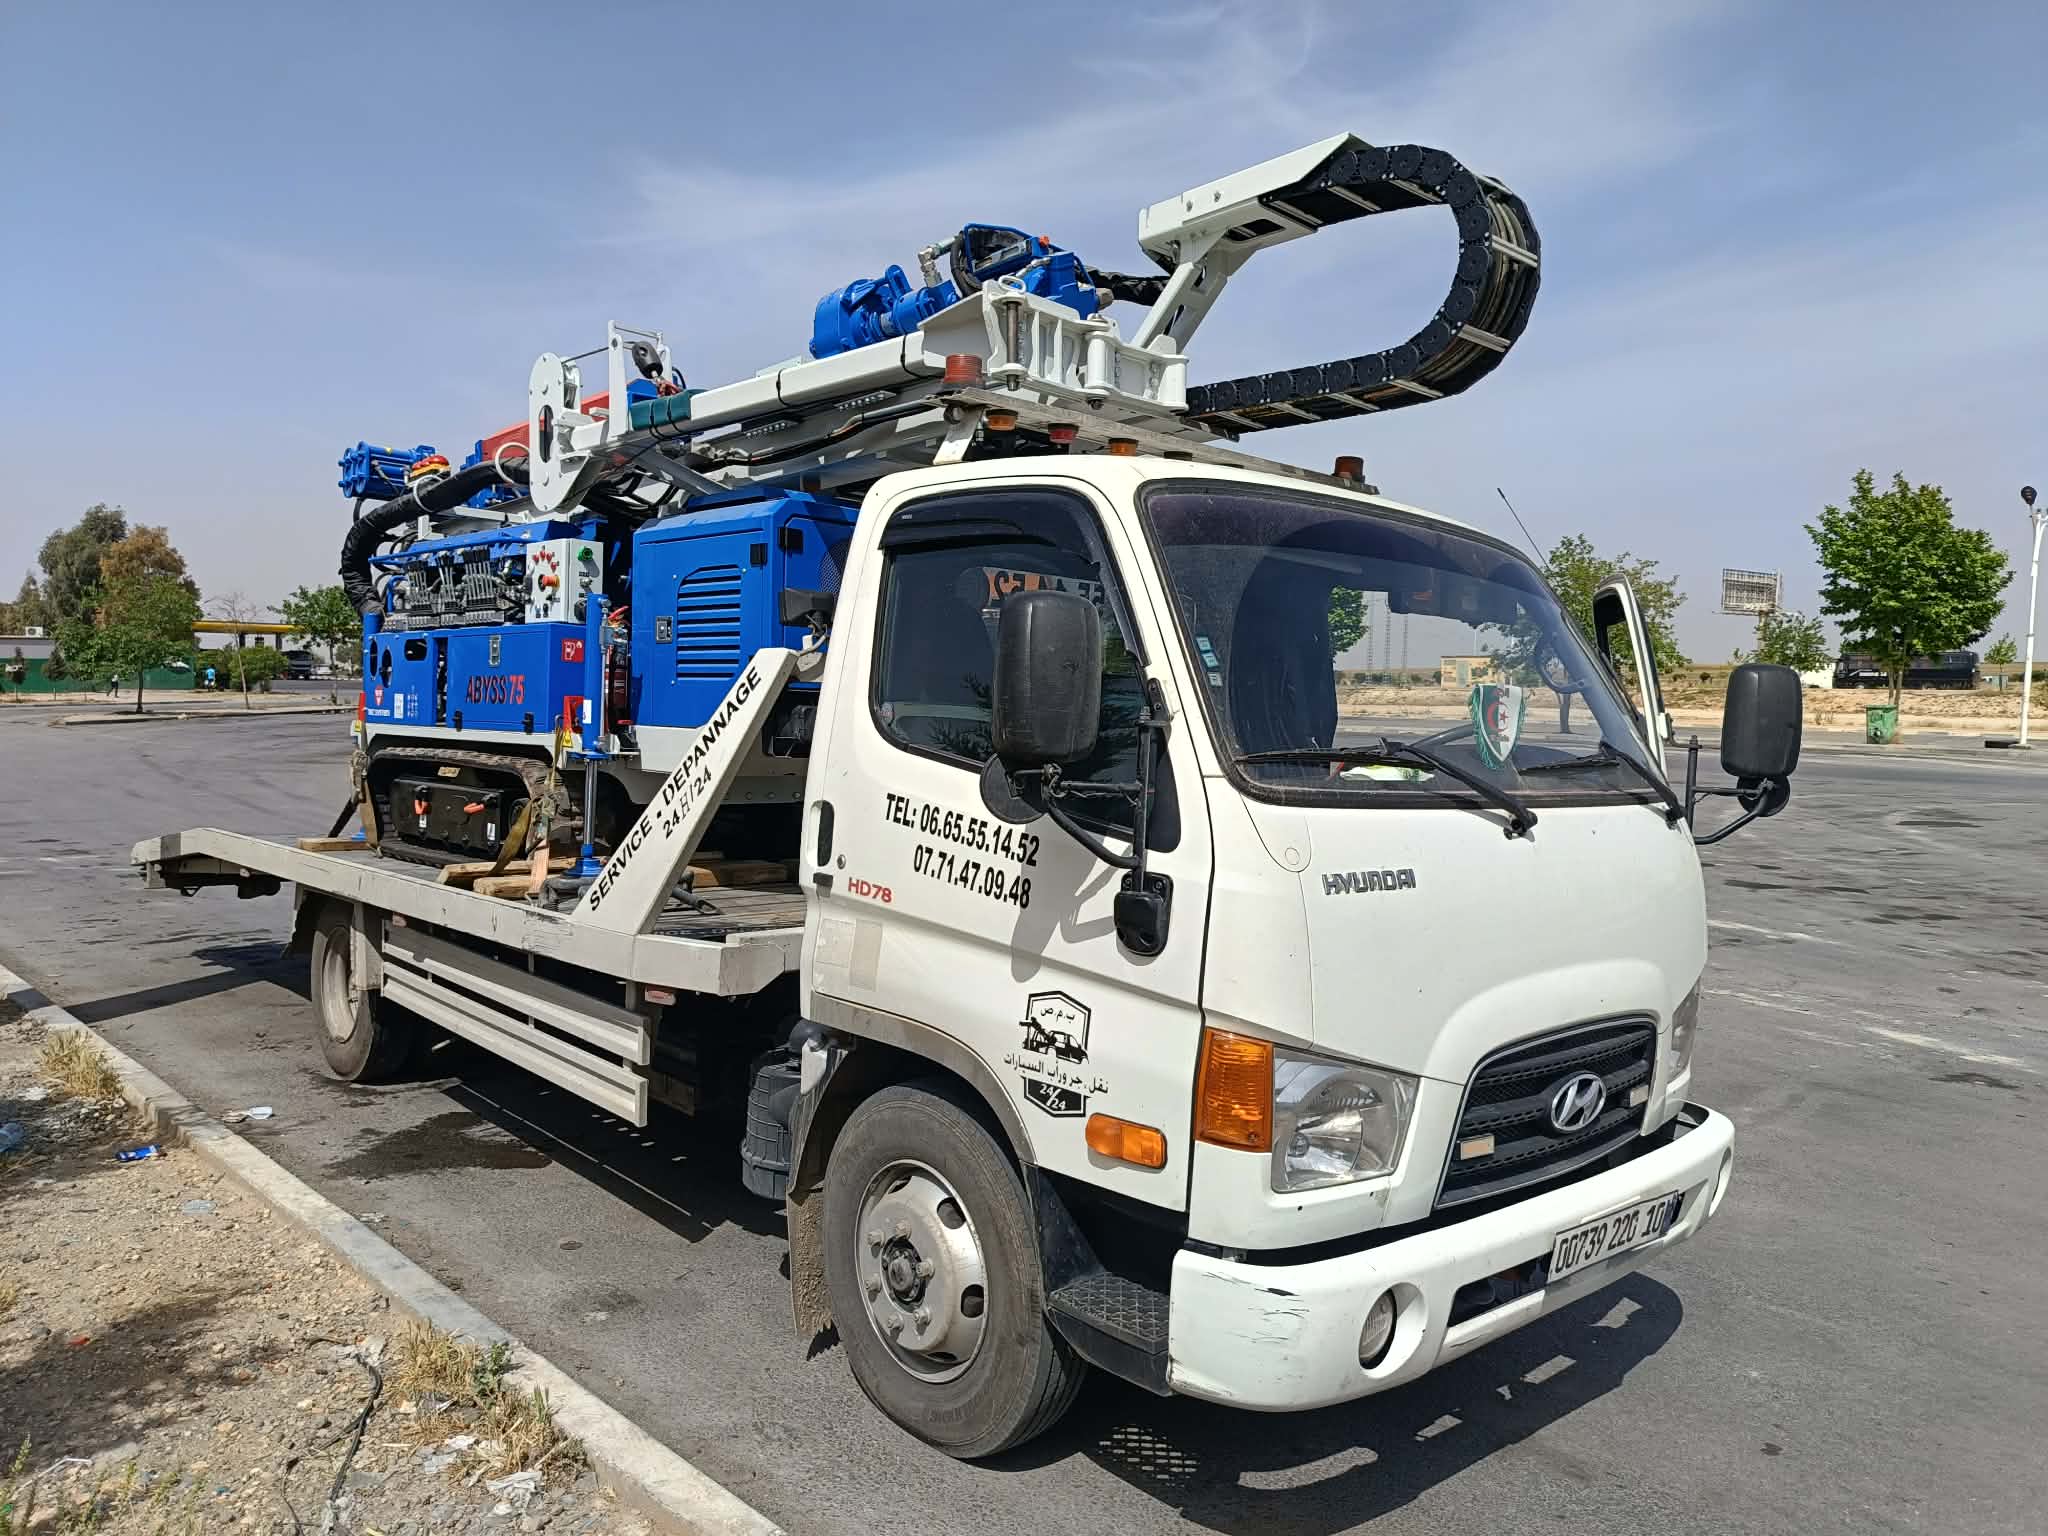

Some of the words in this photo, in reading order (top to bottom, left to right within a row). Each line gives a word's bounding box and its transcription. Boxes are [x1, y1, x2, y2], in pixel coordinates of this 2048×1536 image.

[465, 675, 507, 705] ABYSS
[509, 674, 526, 704] 75
[590, 814, 653, 912] SERVICE
[662, 666, 762, 806] DEPANNAGE
[885, 793, 917, 829] TEL:
[919, 802, 1040, 867] 06.65.55.14.52
[847, 877, 893, 904] HD78
[913, 843, 1032, 909] 07.71.47.09.48
[1322, 868, 1416, 895] HYUNDAI
[1554, 1222, 1608, 1274] 00739
[1607, 1209, 1640, 1251] 220
